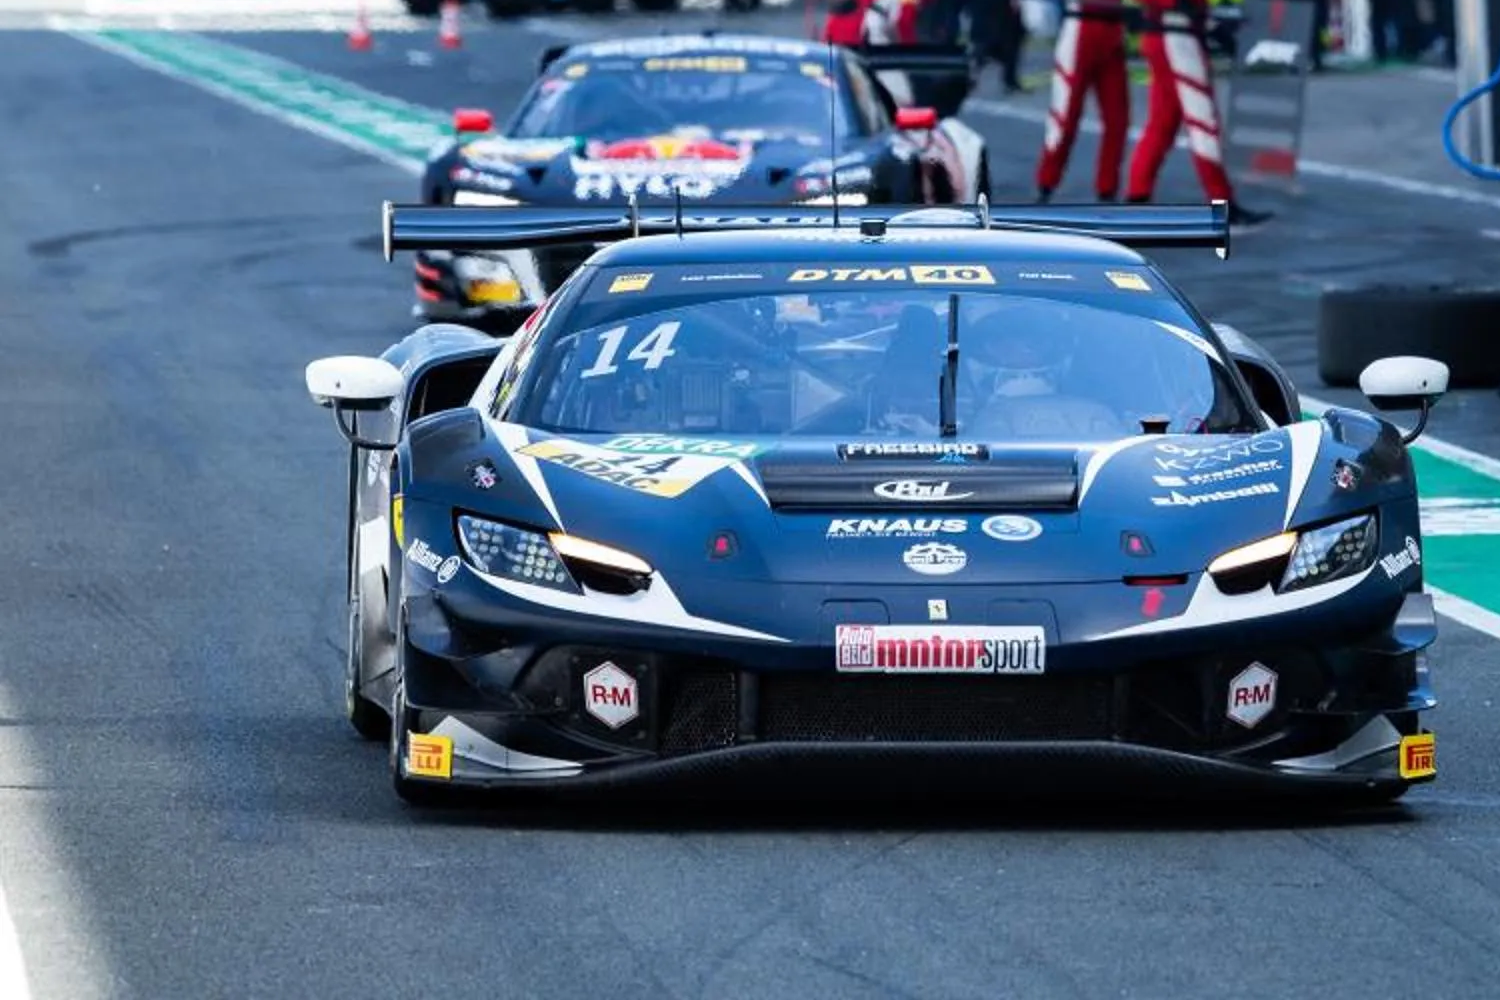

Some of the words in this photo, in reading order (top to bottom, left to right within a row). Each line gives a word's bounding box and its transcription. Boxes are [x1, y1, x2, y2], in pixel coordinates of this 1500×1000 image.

[787, 269, 907, 282] DTM
[919, 267, 981, 282] 40
[580, 321, 682, 379] 14
[602, 437, 758, 458] DEKRA
[826, 518, 969, 533] KNAUS
[877, 635, 1042, 673] motorsport
